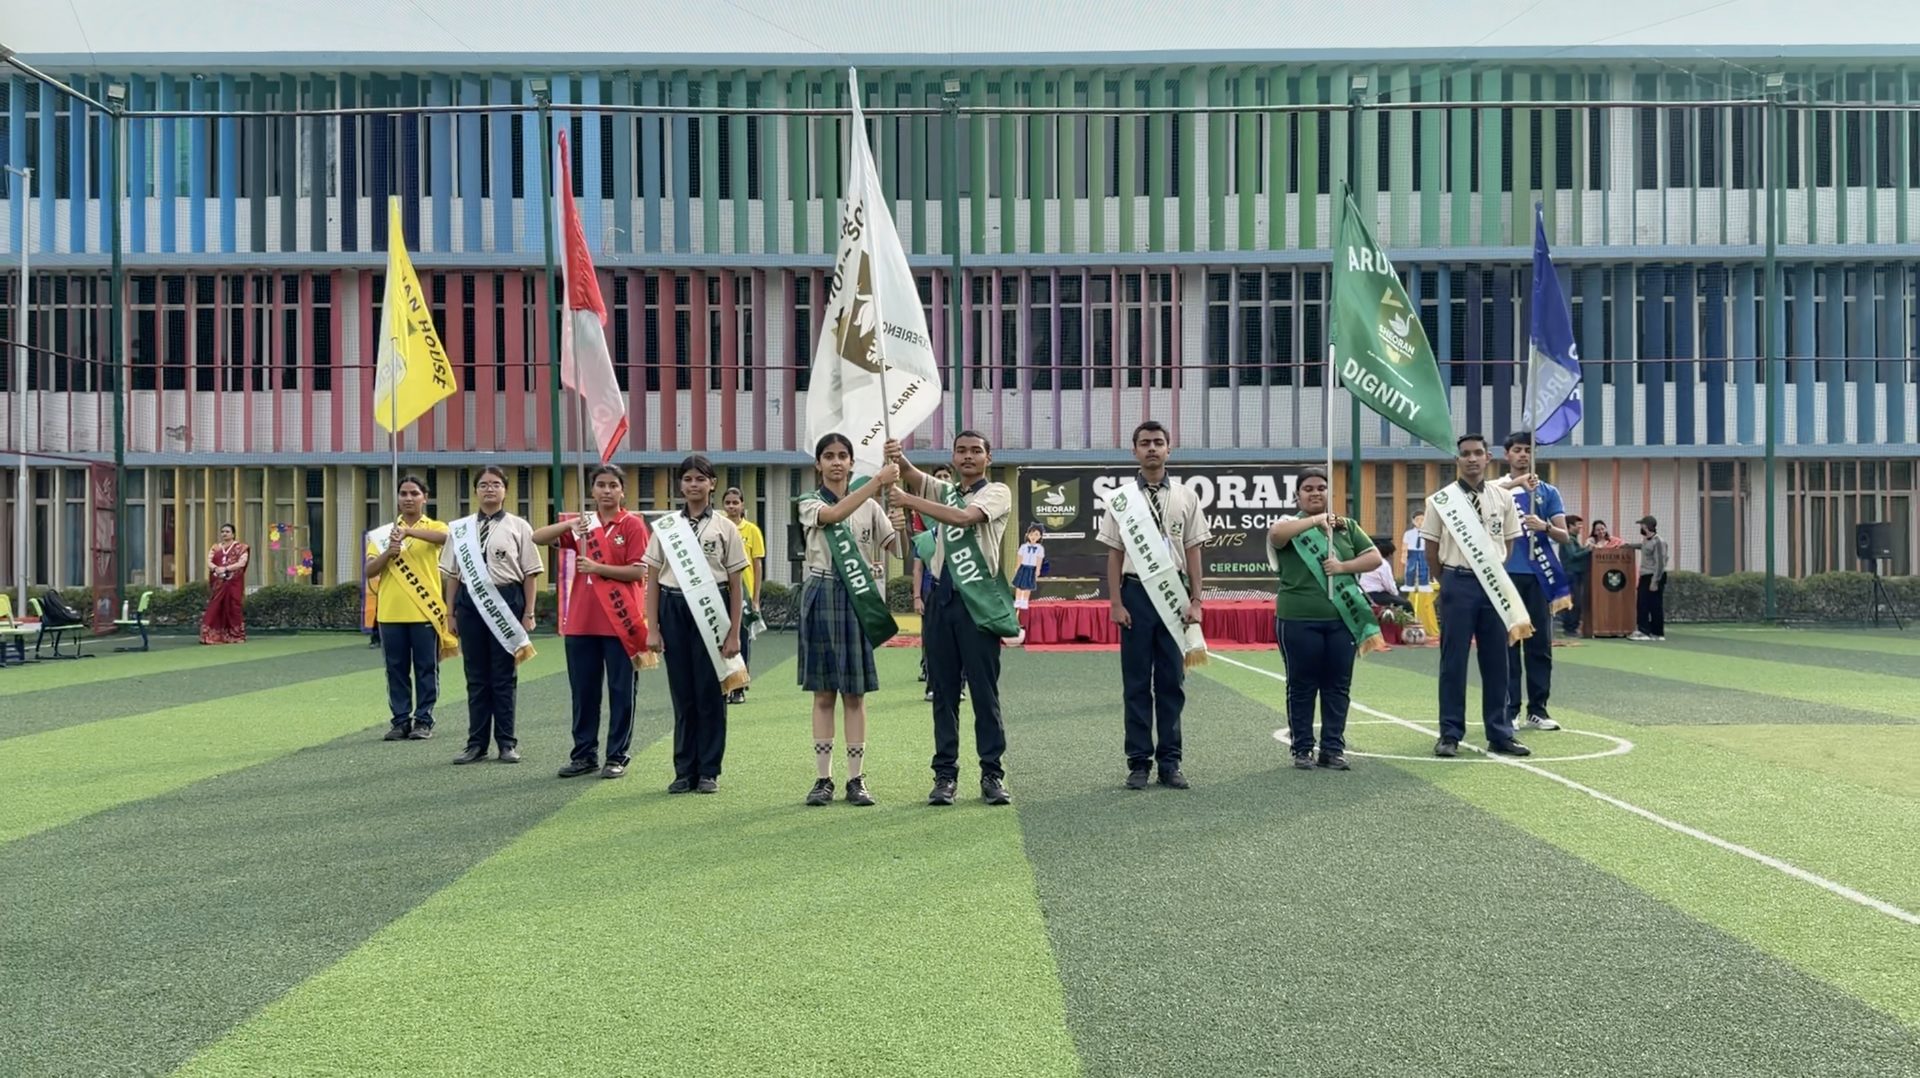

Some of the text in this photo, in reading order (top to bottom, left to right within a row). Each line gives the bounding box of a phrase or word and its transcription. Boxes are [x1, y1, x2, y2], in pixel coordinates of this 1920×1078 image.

[418, 320, 446, 389] HOUSE
[1378, 324, 1415, 355] SHEORAN
[861, 383, 919, 446] PLAY LEARN
[1343, 357, 1421, 421] DIGNITY
[1035, 505, 1076, 513] SHEORAN
[668, 532, 702, 586] SPORTS
[950, 546, 983, 585] BOY
[1126, 516, 1160, 573] SPORTS
[393, 554, 430, 600] HRAVAN
[459, 543, 516, 639] DISCIPLINE CAPTAIN
